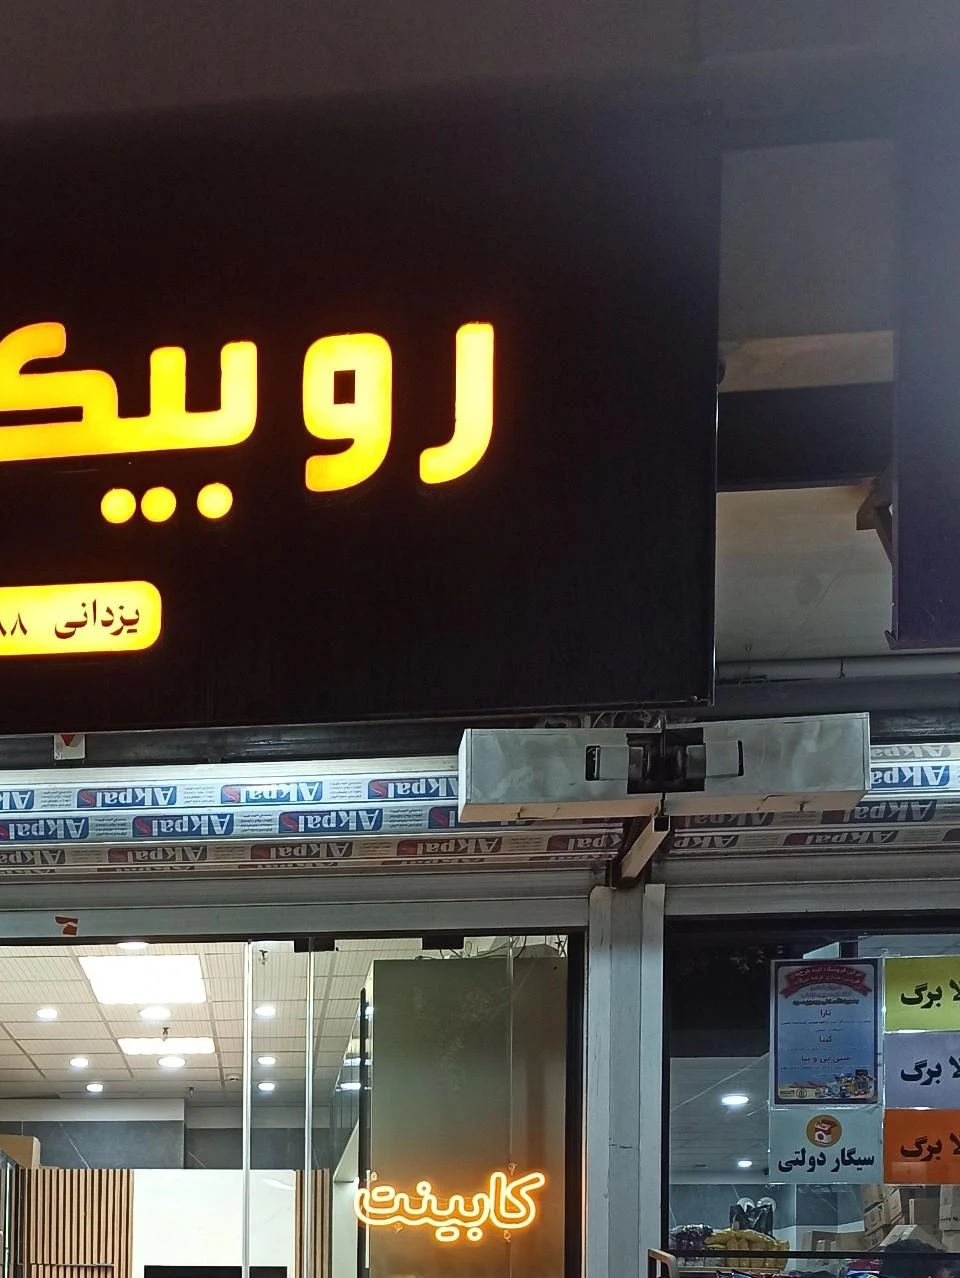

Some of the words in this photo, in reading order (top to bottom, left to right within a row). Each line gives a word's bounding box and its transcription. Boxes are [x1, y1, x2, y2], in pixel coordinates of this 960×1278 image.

[54, 598, 140, 640] یزدانی
[900, 983, 943, 1009] برگ
[900, 1060, 943, 1086] برگ
[778, 1147, 827, 1173] دولتی
[831, 1147, 875, 1173] سیگار
[900, 1136, 943, 1162] برگ
[354, 1171, 546, 1242] کابینت
